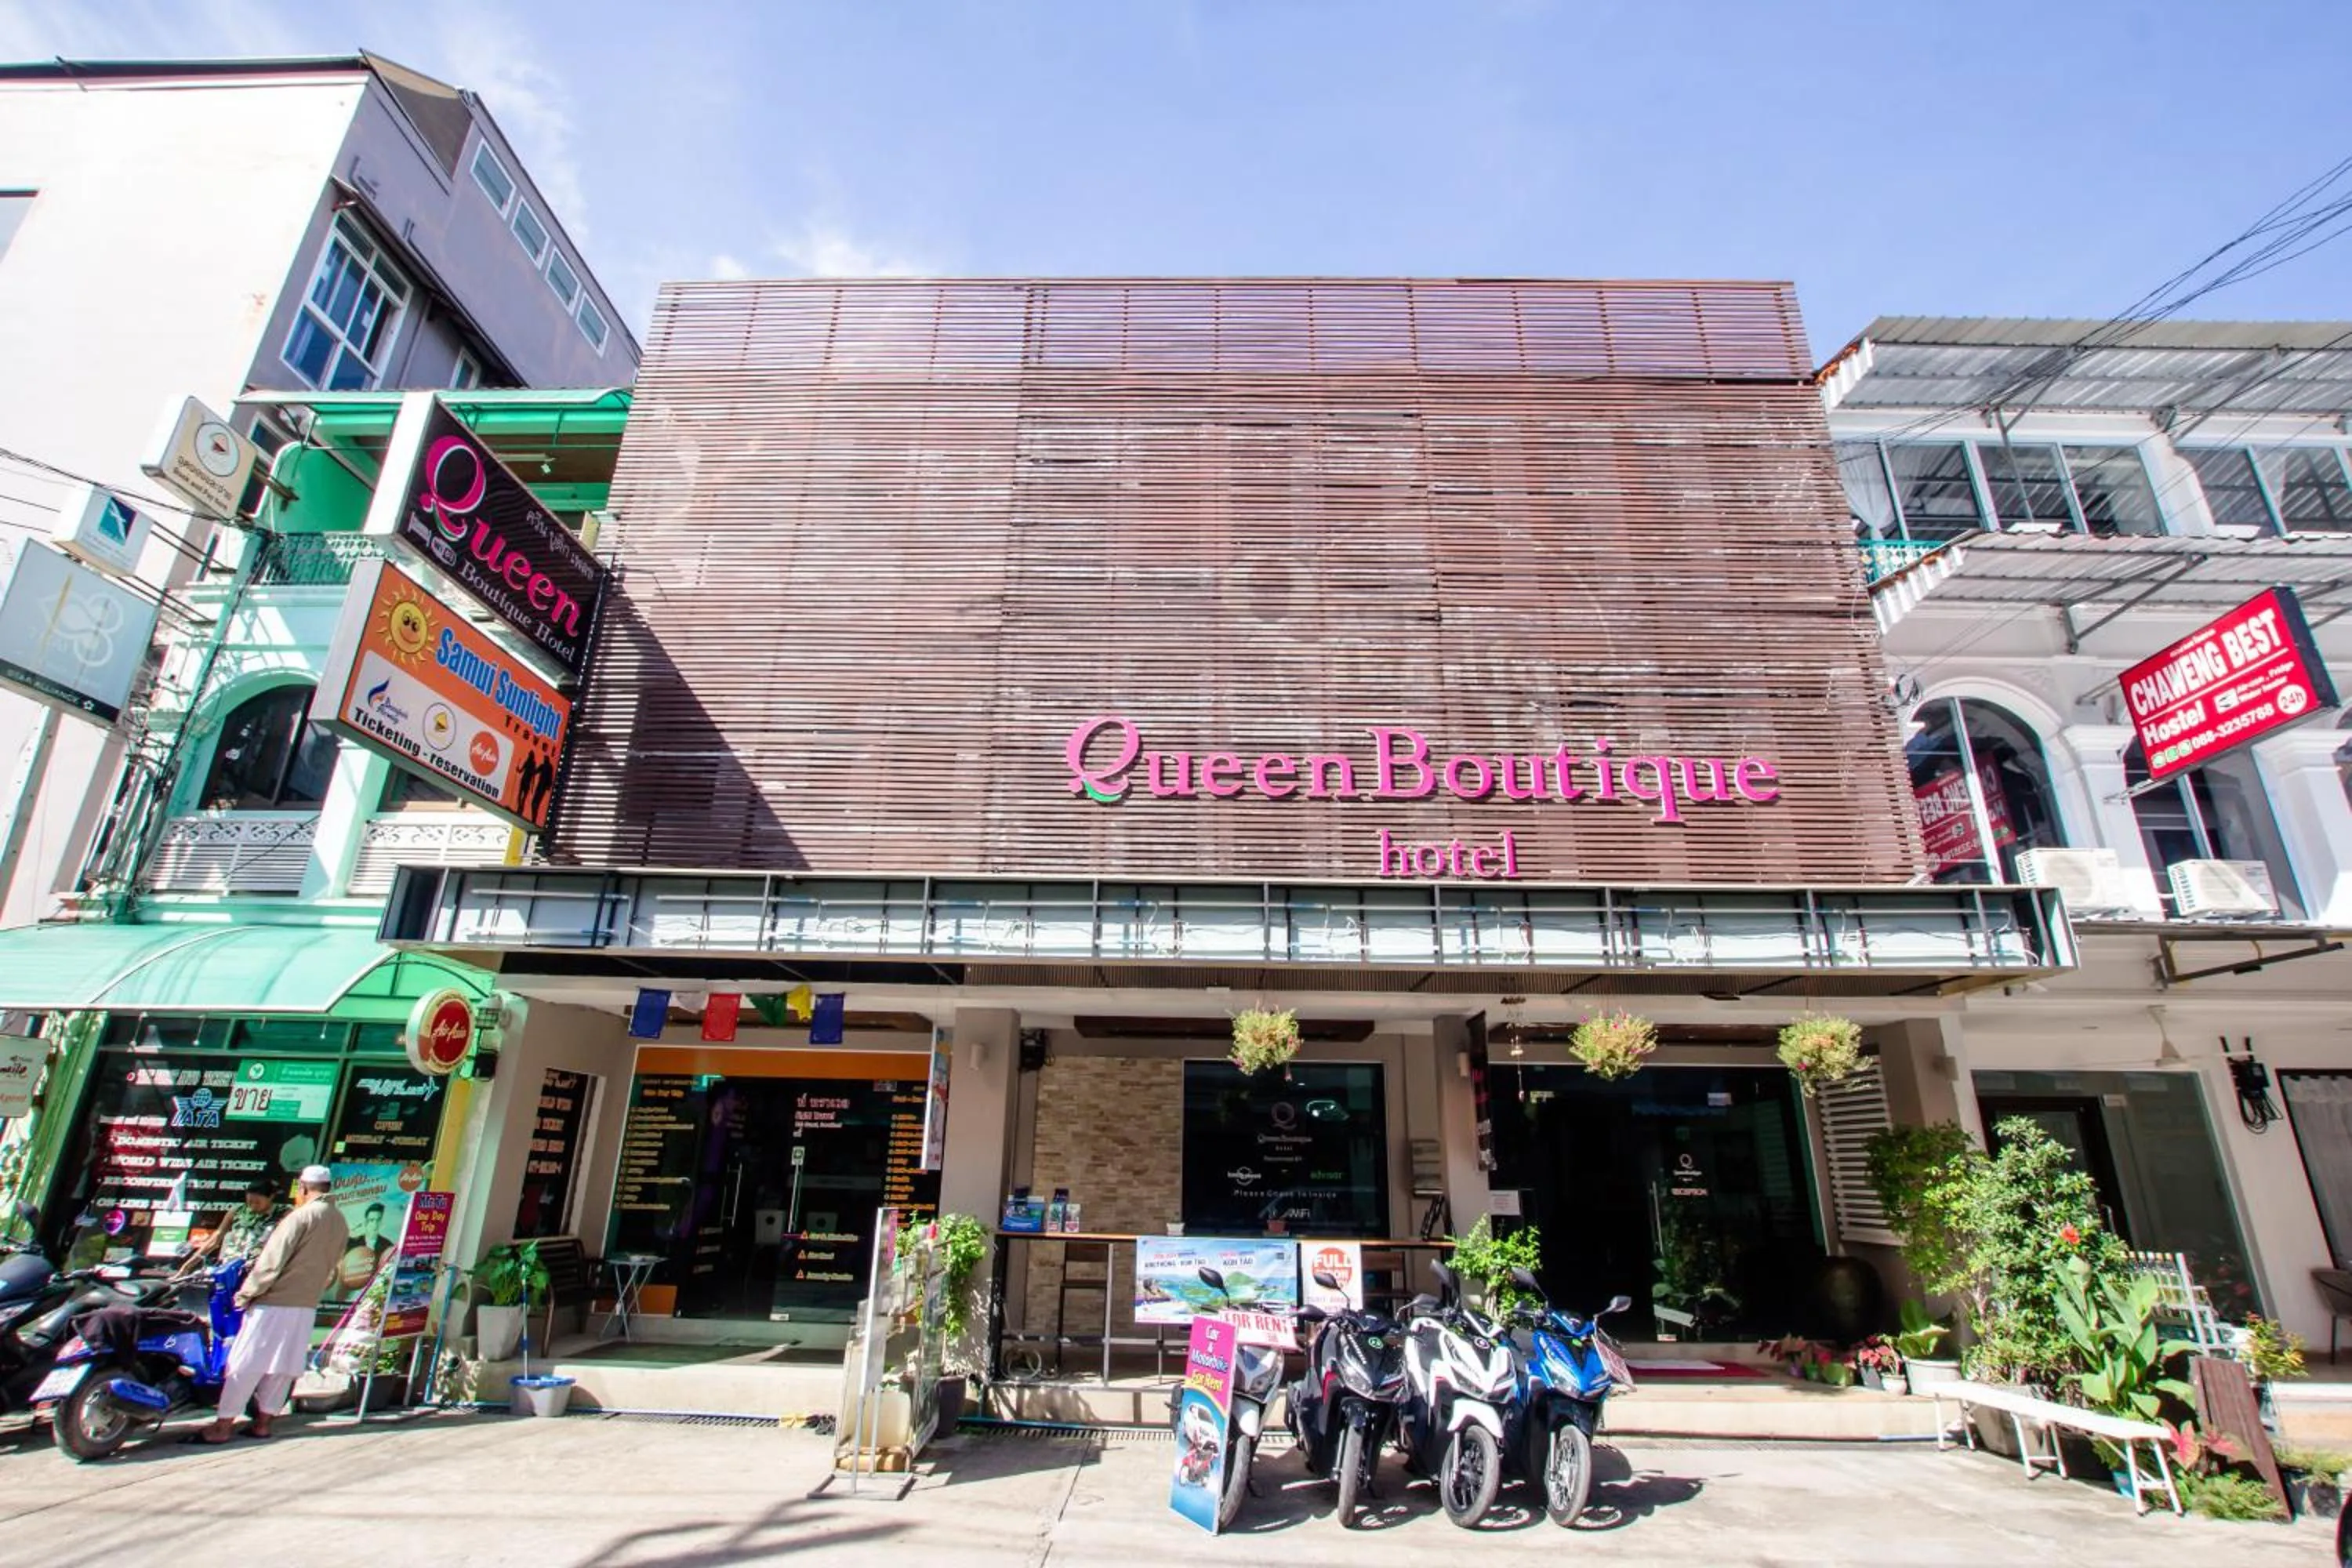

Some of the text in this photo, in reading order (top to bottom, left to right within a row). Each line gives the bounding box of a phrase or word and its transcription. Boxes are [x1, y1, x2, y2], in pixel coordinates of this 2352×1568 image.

[419, 435, 581, 637] Queen
[458, 560, 577, 663] Boutique Hotel
[2130, 639, 2228, 717] CHAWENG
[2220, 608, 2281, 669] BEST
[436, 626, 563, 742] Samui Sunlight
[2141, 699, 2207, 747] Hostel
[504, 714, 558, 758] Travel
[354, 706, 421, 758] Ticketing
[429, 752, 500, 799] reservation
[1376, 828, 1519, 878] hotel
[171, 1110, 221, 1127] IATA
[210, 1139, 258, 1149] TICKET
[220, 1160, 267, 1171] TICKET
[414, 1210, 446, 1222] One Day
[420, 1221, 436, 1234] Trip
[1312, 1254, 1352, 1268] FULL
[1206, 1323, 1220, 1341] Car
[1225, 1312, 1288, 1333] FOR RENT
[1204, 1372, 1223, 1392] Rent
